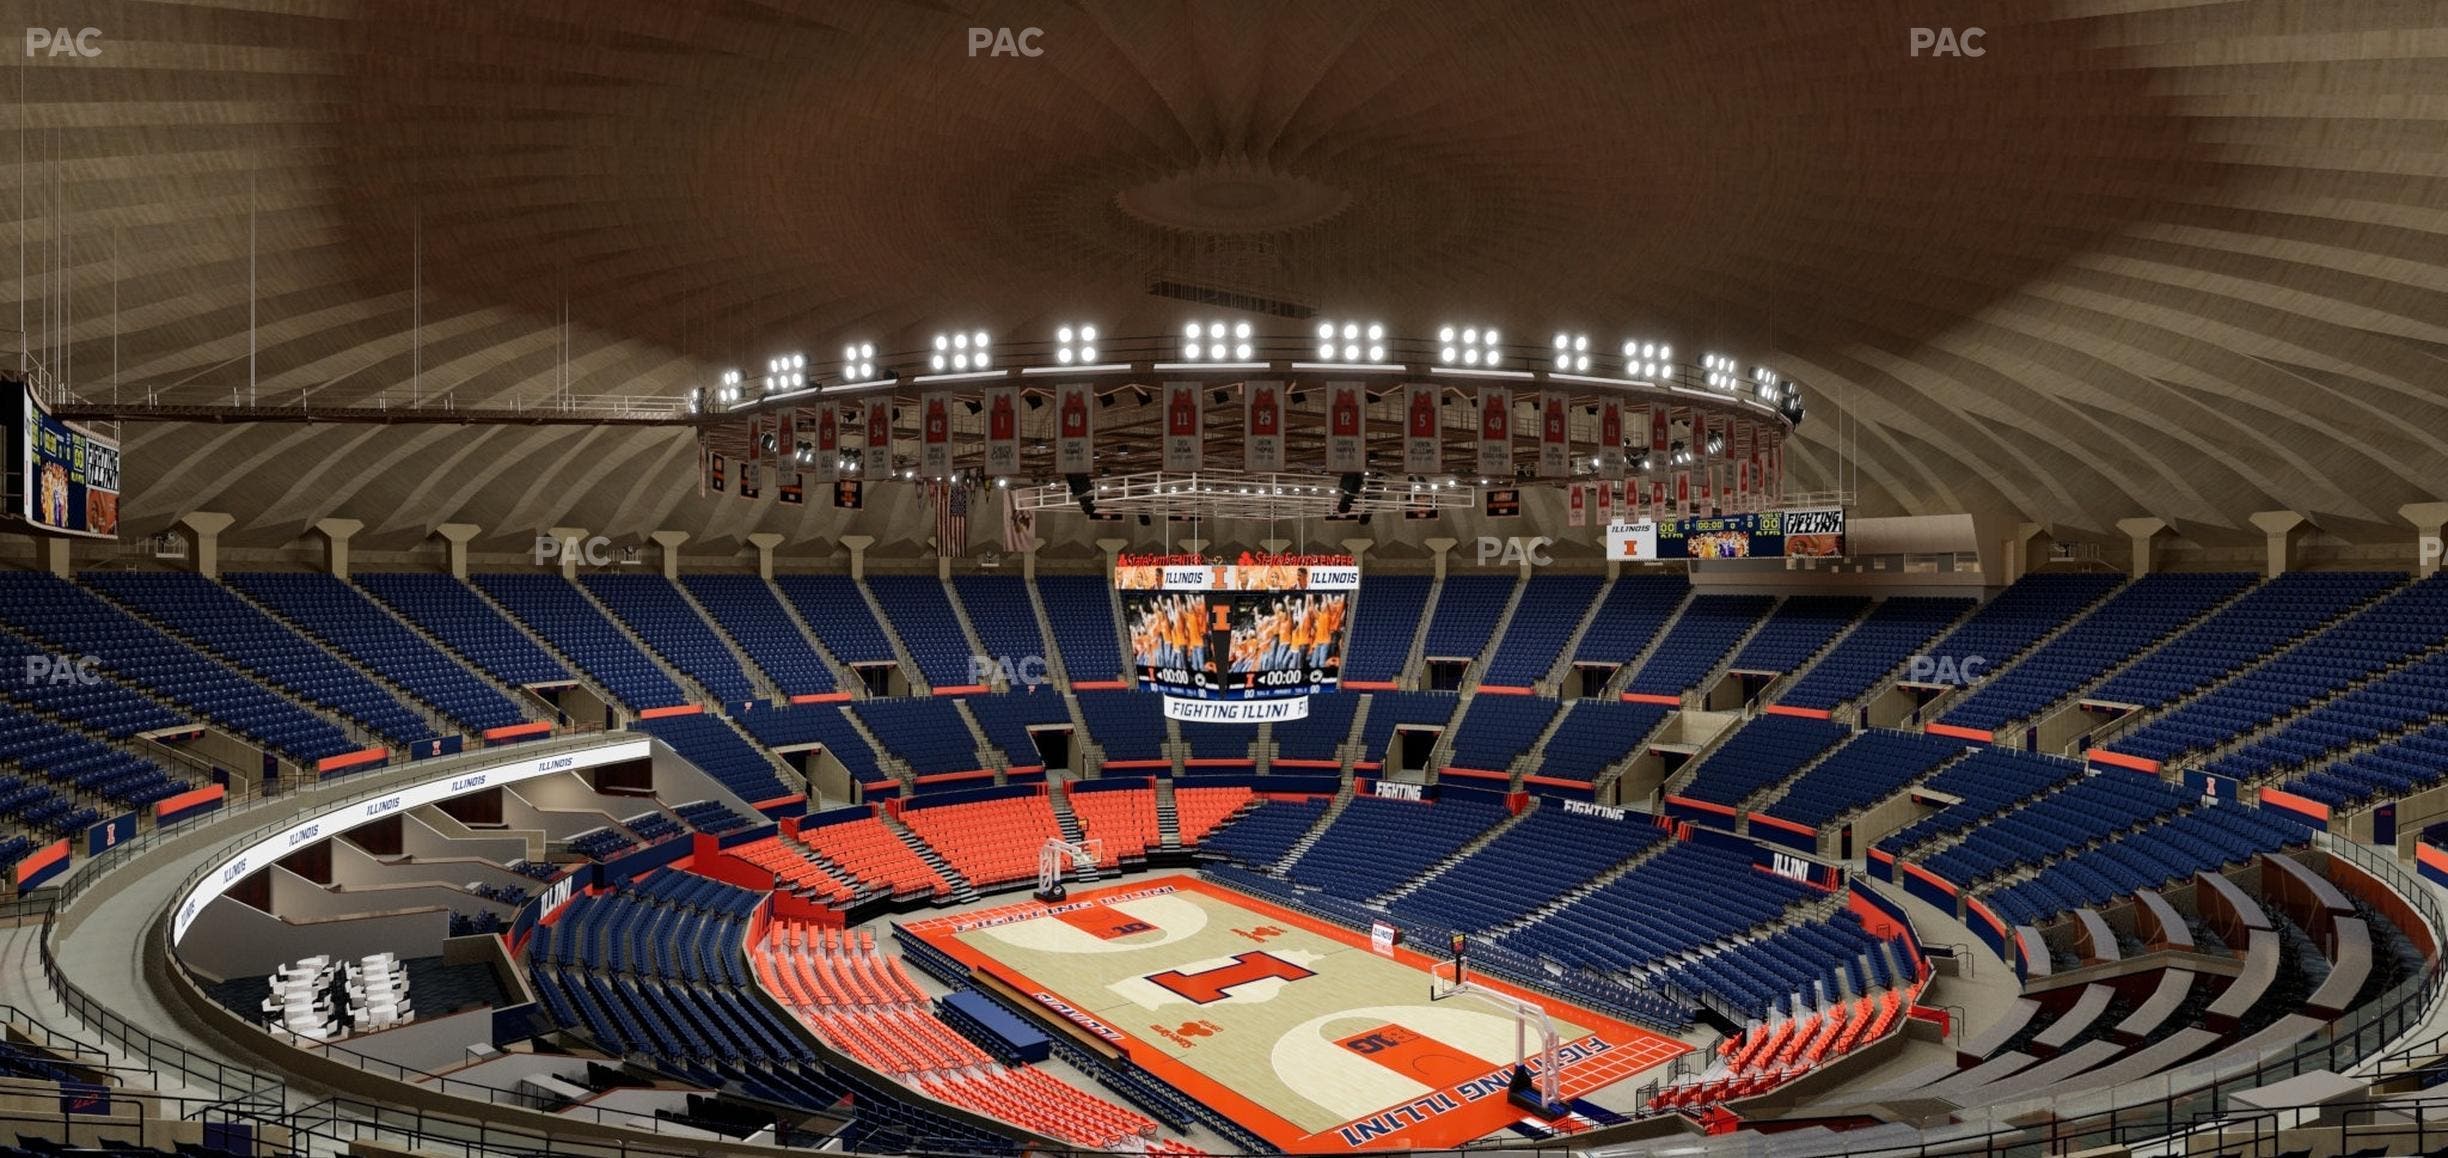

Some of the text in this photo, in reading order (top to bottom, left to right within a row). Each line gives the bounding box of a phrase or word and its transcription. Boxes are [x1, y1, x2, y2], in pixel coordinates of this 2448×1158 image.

[1698, 521, 1723, 530] 00:00
[1763, 519, 1778, 528] 00
[1787, 512, 1840, 524] FIGHTING
[1612, 525, 1651, 533] ILLINOIS
[1660, 523, 1675, 532] 00
[1787, 521, 1842, 534] ILLINI
[1165, 572, 1203, 584] ILLINOIS
[1310, 572, 1358, 584] ILLINOIS
[1162, 668, 1189, 684] 00:00
[1267, 670, 1302, 686] 00:00
[1172, 703, 1239, 719] FIGHTING
[1242, 704, 1289, 719] ILLINI
[538, 757, 573, 772] ILLINOIS
[451, 775, 486, 792] ILLINOIS
[1376, 782, 1421, 801] FIGHTING
[366, 797, 400, 816] ILLINOIS
[1564, 800, 1625, 820] FIGHTING
[289, 825, 319, 847] ILLINOIS
[1773, 852, 1809, 882] ILLINI
[540, 875, 573, 920] ILLINI
[1338, 1093, 1461, 1148] ILLINI
